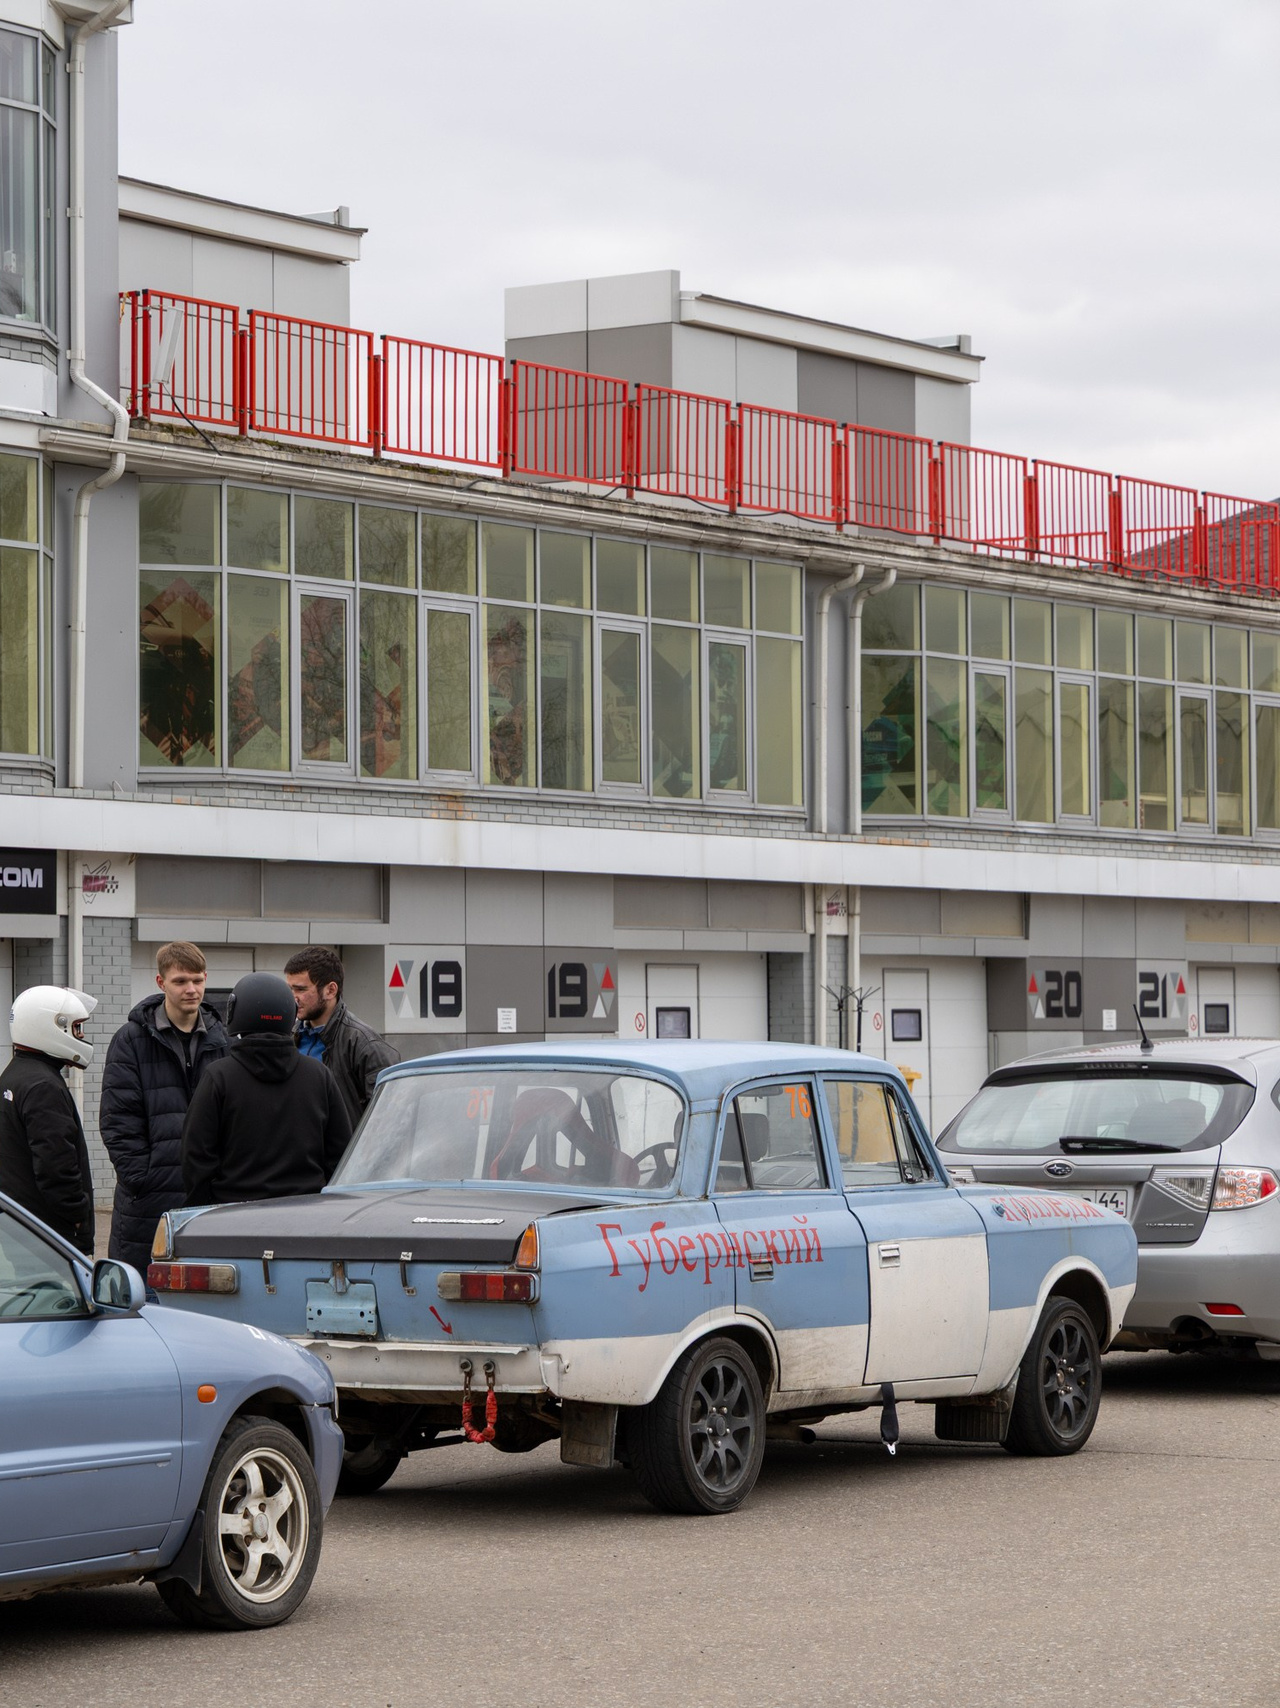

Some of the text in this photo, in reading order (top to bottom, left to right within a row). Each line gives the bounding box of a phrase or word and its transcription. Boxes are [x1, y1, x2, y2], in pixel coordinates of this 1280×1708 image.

[419, 960, 462, 1018] 18
[548, 962, 588, 1018] 19
[1045, 970, 1082, 1018] 20
[1138, 972, 1167, 1018] 21
[784, 1086, 812, 1119] 76
[1098, 1192, 1120, 1209] 44
[596, 1215, 825, 1293] Губернский
